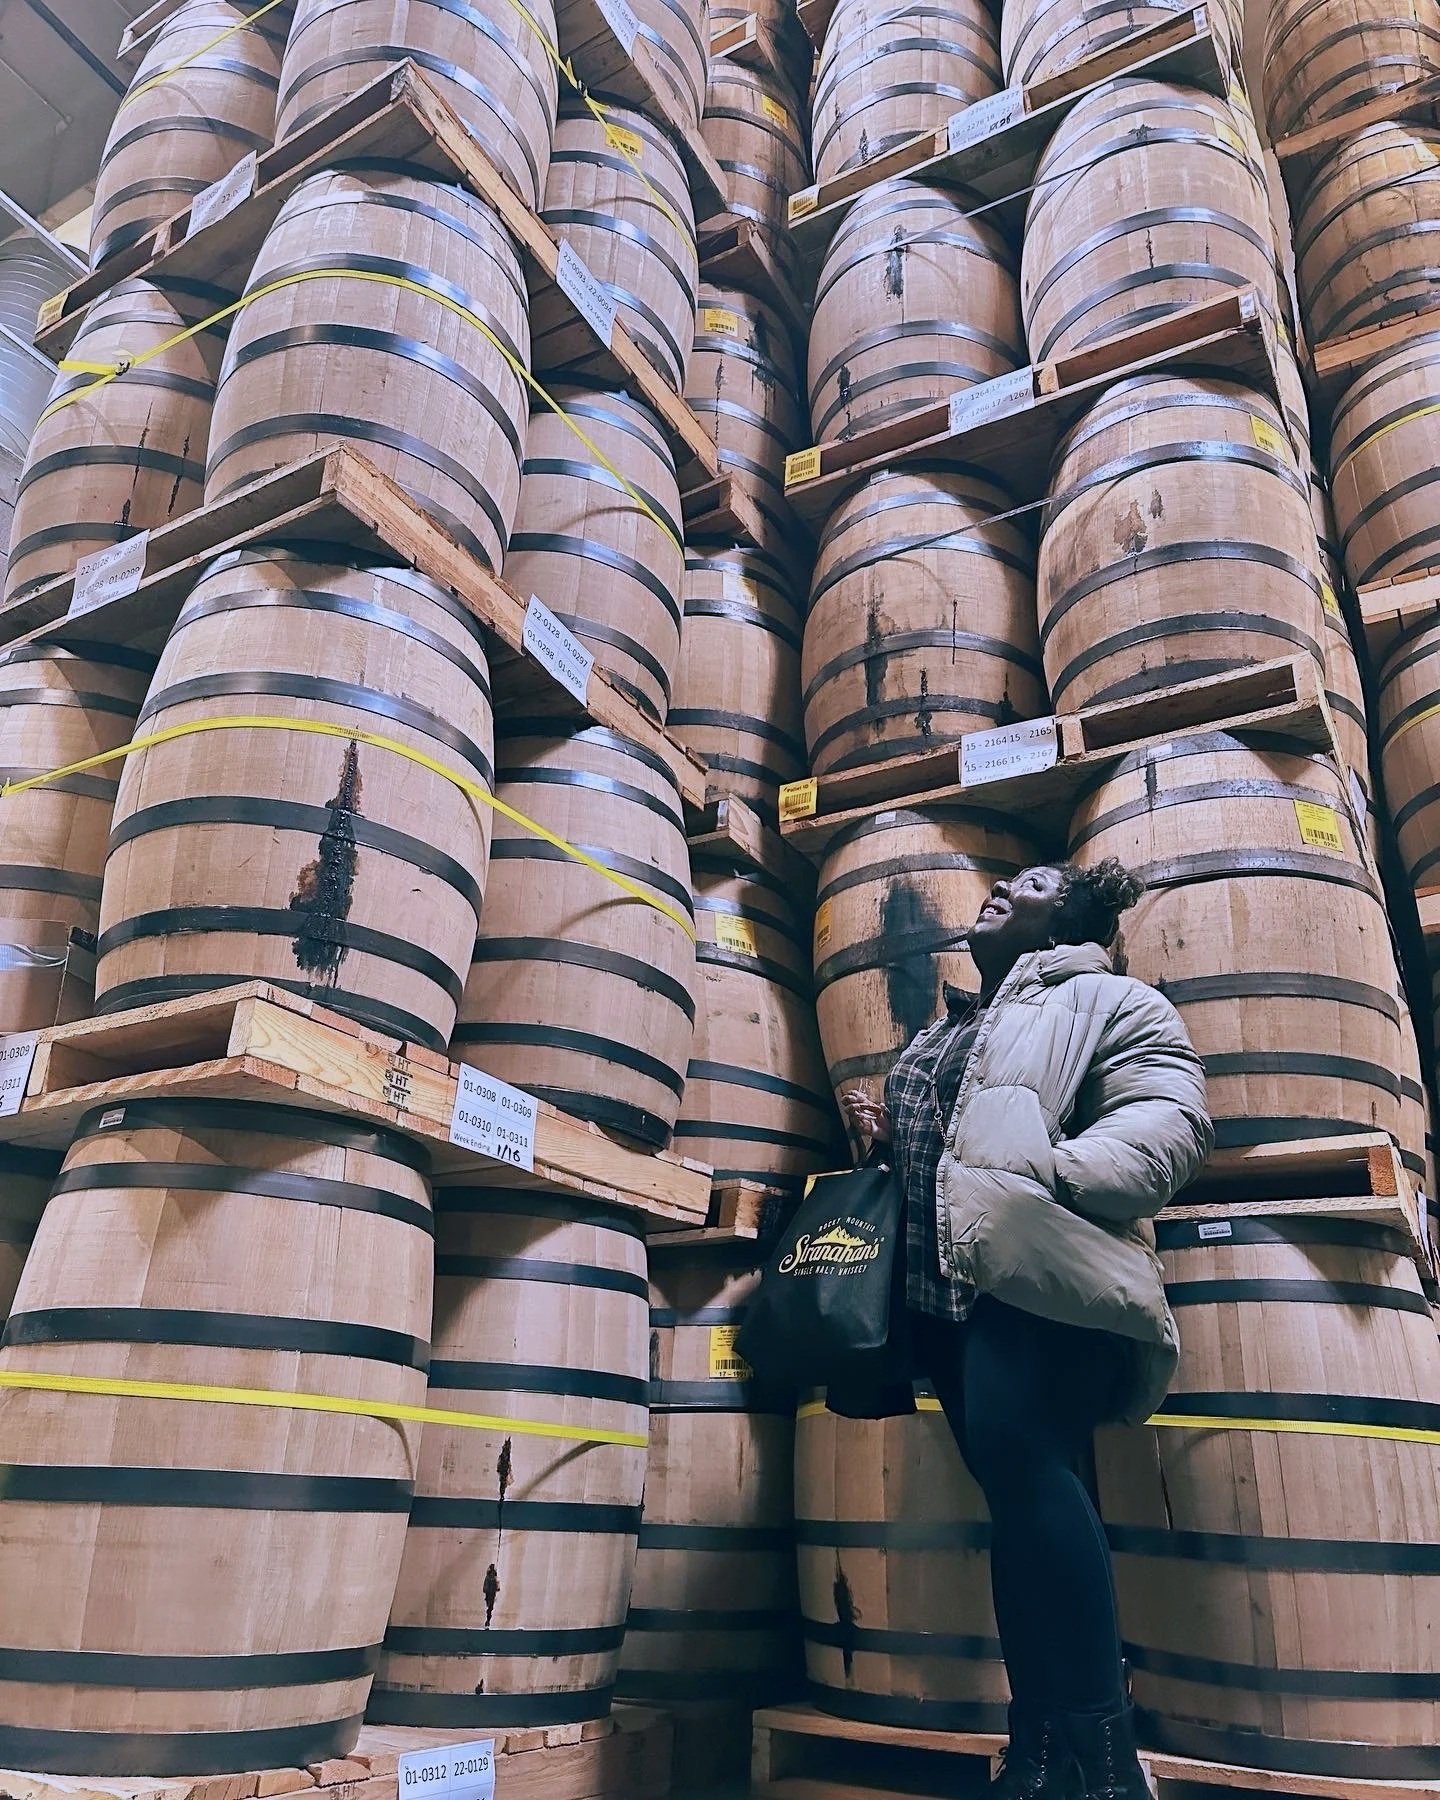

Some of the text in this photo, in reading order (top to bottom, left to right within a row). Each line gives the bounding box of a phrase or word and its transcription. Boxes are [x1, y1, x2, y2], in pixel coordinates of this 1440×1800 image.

[563, 251, 586, 283] 22-0093
[588, 284, 612, 314] 22-0094
[1009, 388, 1029, 402] 1267
[527, 629, 555, 660] 01-0298
[532, 608, 561, 639] 22-0128
[563, 638, 588, 668] 01-0297
[966, 742, 977, 752] 15
[985, 736, 1007, 748] 2164
[1010, 733, 1021, 743] 15
[1029, 726, 1052, 738] 2165
[966, 764, 977, 772] 15
[985, 757, 1008, 769] 2166
[1010, 754, 1021, 763] 15
[1030, 749, 1053, 759] 2167
[398, 1057, 411, 1071] HT
[396, 1074, 409, 1087] HT
[394, 1091, 406, 1104] HT
[463, 1080, 532, 1118] 01-0308 01-0309
[458, 1110, 528, 1148] 01-0310 01-0311
[453, 1132, 491, 1152] Week Ending
[818, 1216, 876, 1233] ROCKY MOUNTAIN
[778, 1234, 880, 1273] Stranahan's
[793, 1264, 867, 1277] SINGLE MALT WHISKEY
[405, 1756, 489, 1785] 01-0312 22-0129
